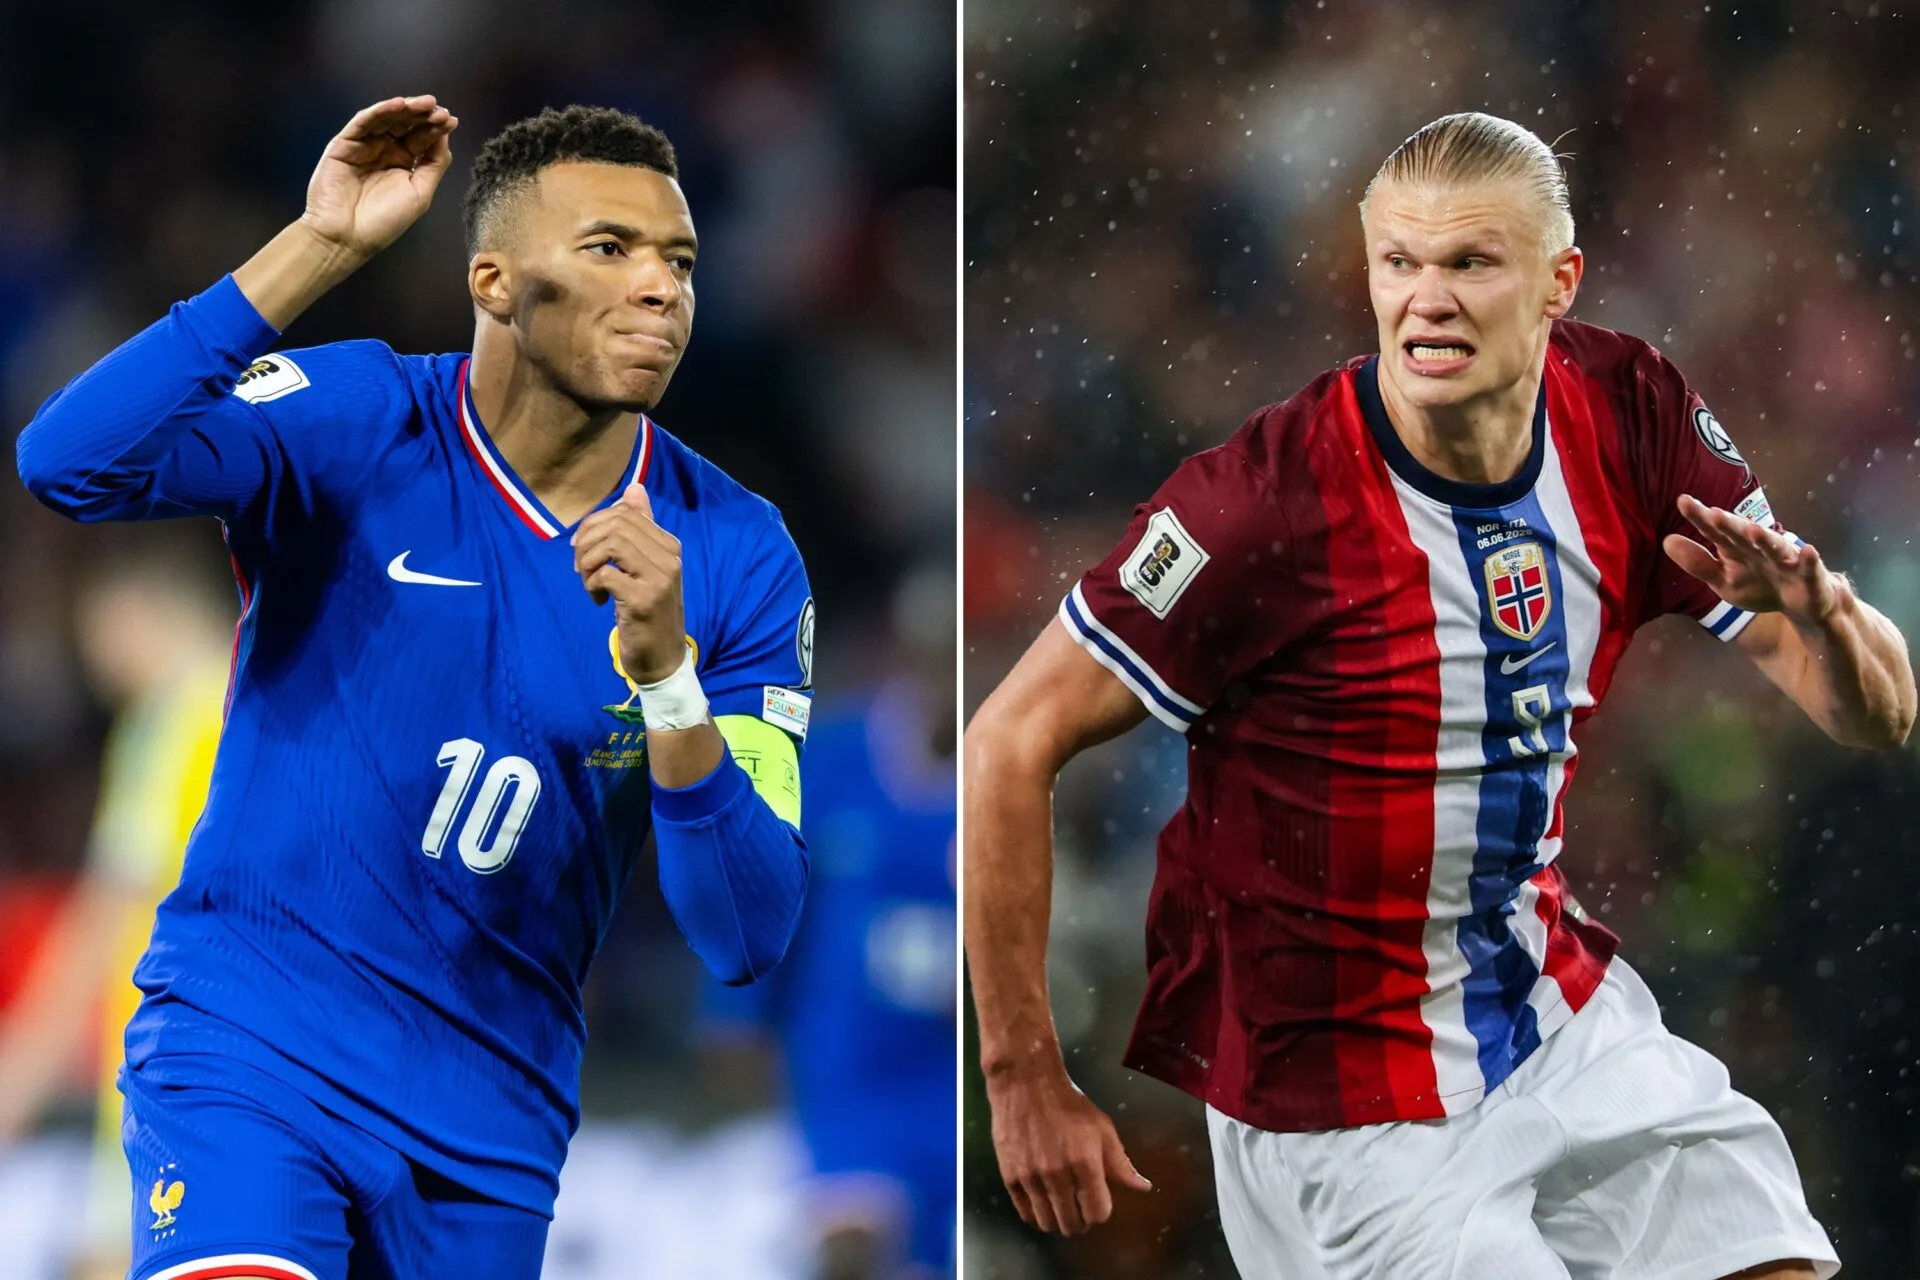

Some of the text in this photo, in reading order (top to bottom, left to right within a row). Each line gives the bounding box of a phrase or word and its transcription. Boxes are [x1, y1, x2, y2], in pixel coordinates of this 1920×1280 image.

[1477, 523, 1500, 535] NOR
[1510, 518, 1527, 528] ITA
[767, 688, 786, 698] UEFA
[1508, 684, 1552, 758] 9
[422, 738, 541, 875] 10
